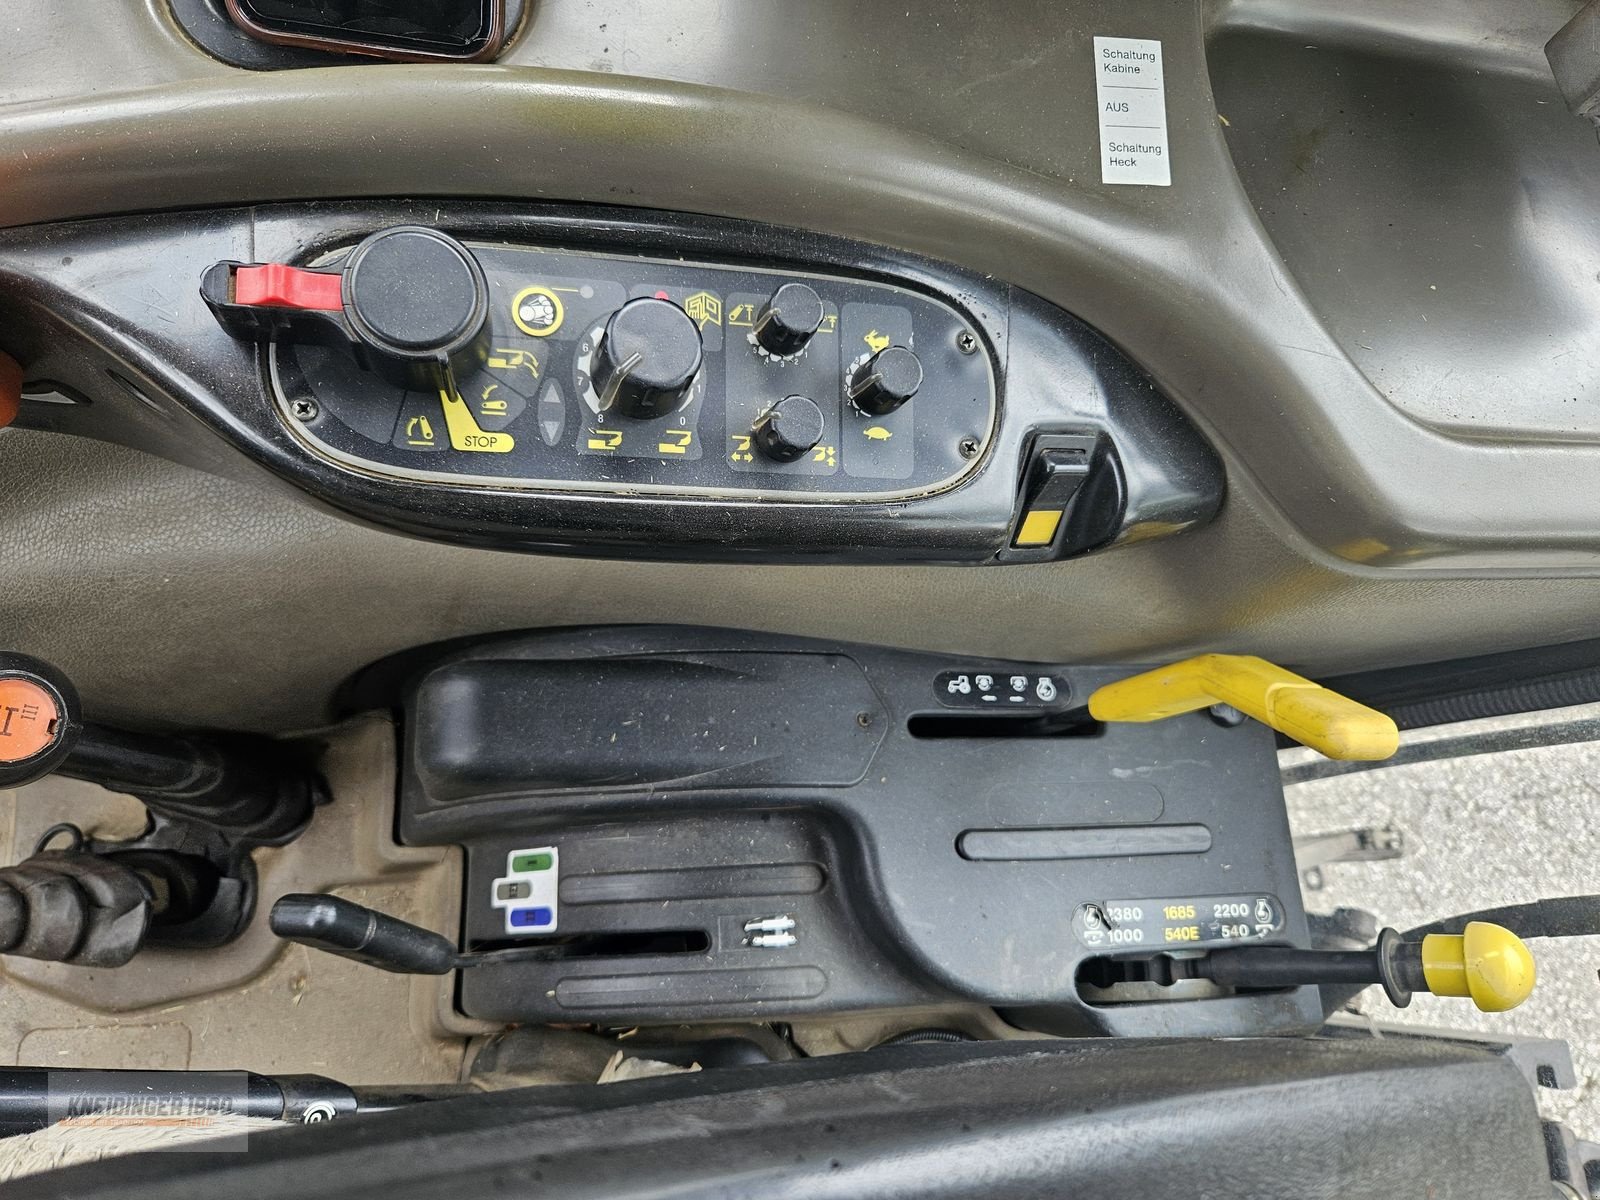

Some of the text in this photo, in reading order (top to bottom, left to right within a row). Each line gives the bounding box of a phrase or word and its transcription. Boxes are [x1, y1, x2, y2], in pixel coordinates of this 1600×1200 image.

[1102, 48, 1156, 63] Schaltung
[1103, 63, 1141, 74] Kabine
[1105, 102, 1129, 113] AUS
[1108, 142, 1162, 156] Schaltung
[1109, 156, 1137, 167] Heck
[582, 343, 589, 353] 6
[597, 413, 604, 424] 8
[679, 416, 686, 426] 0
[464, 435, 498, 448] STOP
[1162, 905, 1196, 920] 1685
[1213, 903, 1249, 919] 2200
[1107, 924, 1249, 944] 1000 540E 540
